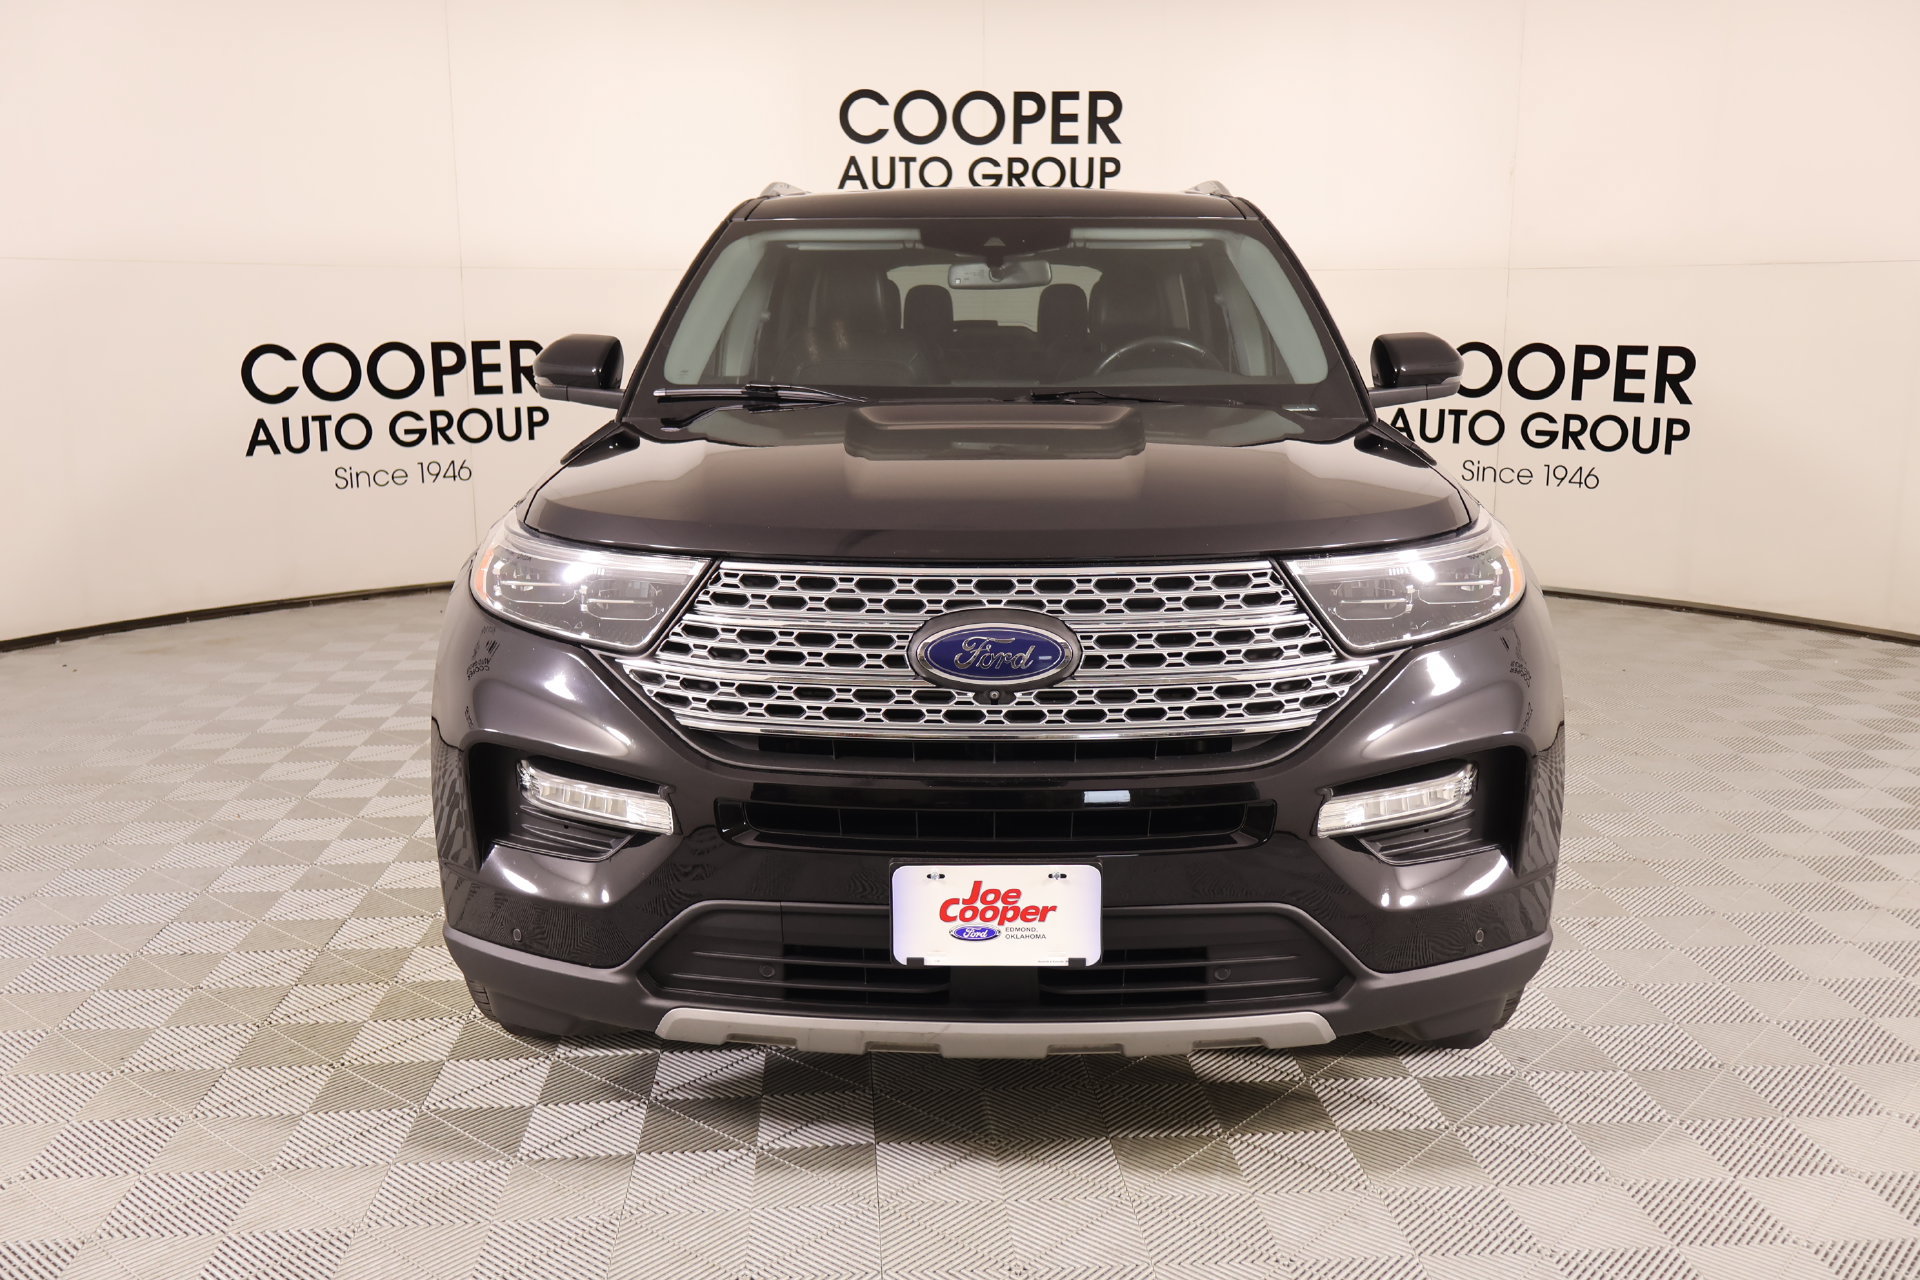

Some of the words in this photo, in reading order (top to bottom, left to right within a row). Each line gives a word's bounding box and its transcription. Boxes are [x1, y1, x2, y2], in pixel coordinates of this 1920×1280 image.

[839, 88, 1123, 146] COOPER
[837, 155, 953, 190] AUTO
[968, 156, 1121, 190] GROUP
[241, 340, 544, 404] COOPER
[1456, 341, 1697, 405] OOPER
[245, 412, 373, 456] AUTO
[388, 406, 550, 448] GROUP
[1390, 407, 1505, 446] AUTO
[1520, 411, 1691, 455] GROUP
[334, 466, 409, 490] Since
[416, 459, 473, 484] 1946
[1461, 459, 1534, 486] Since
[1543, 464, 1600, 490] 1946
[953, 636, 1036, 670] Ford
[961, 880, 1022, 906] Joe
[939, 898, 1058, 926] Cooper
[962, 927, 989, 938] Ford
